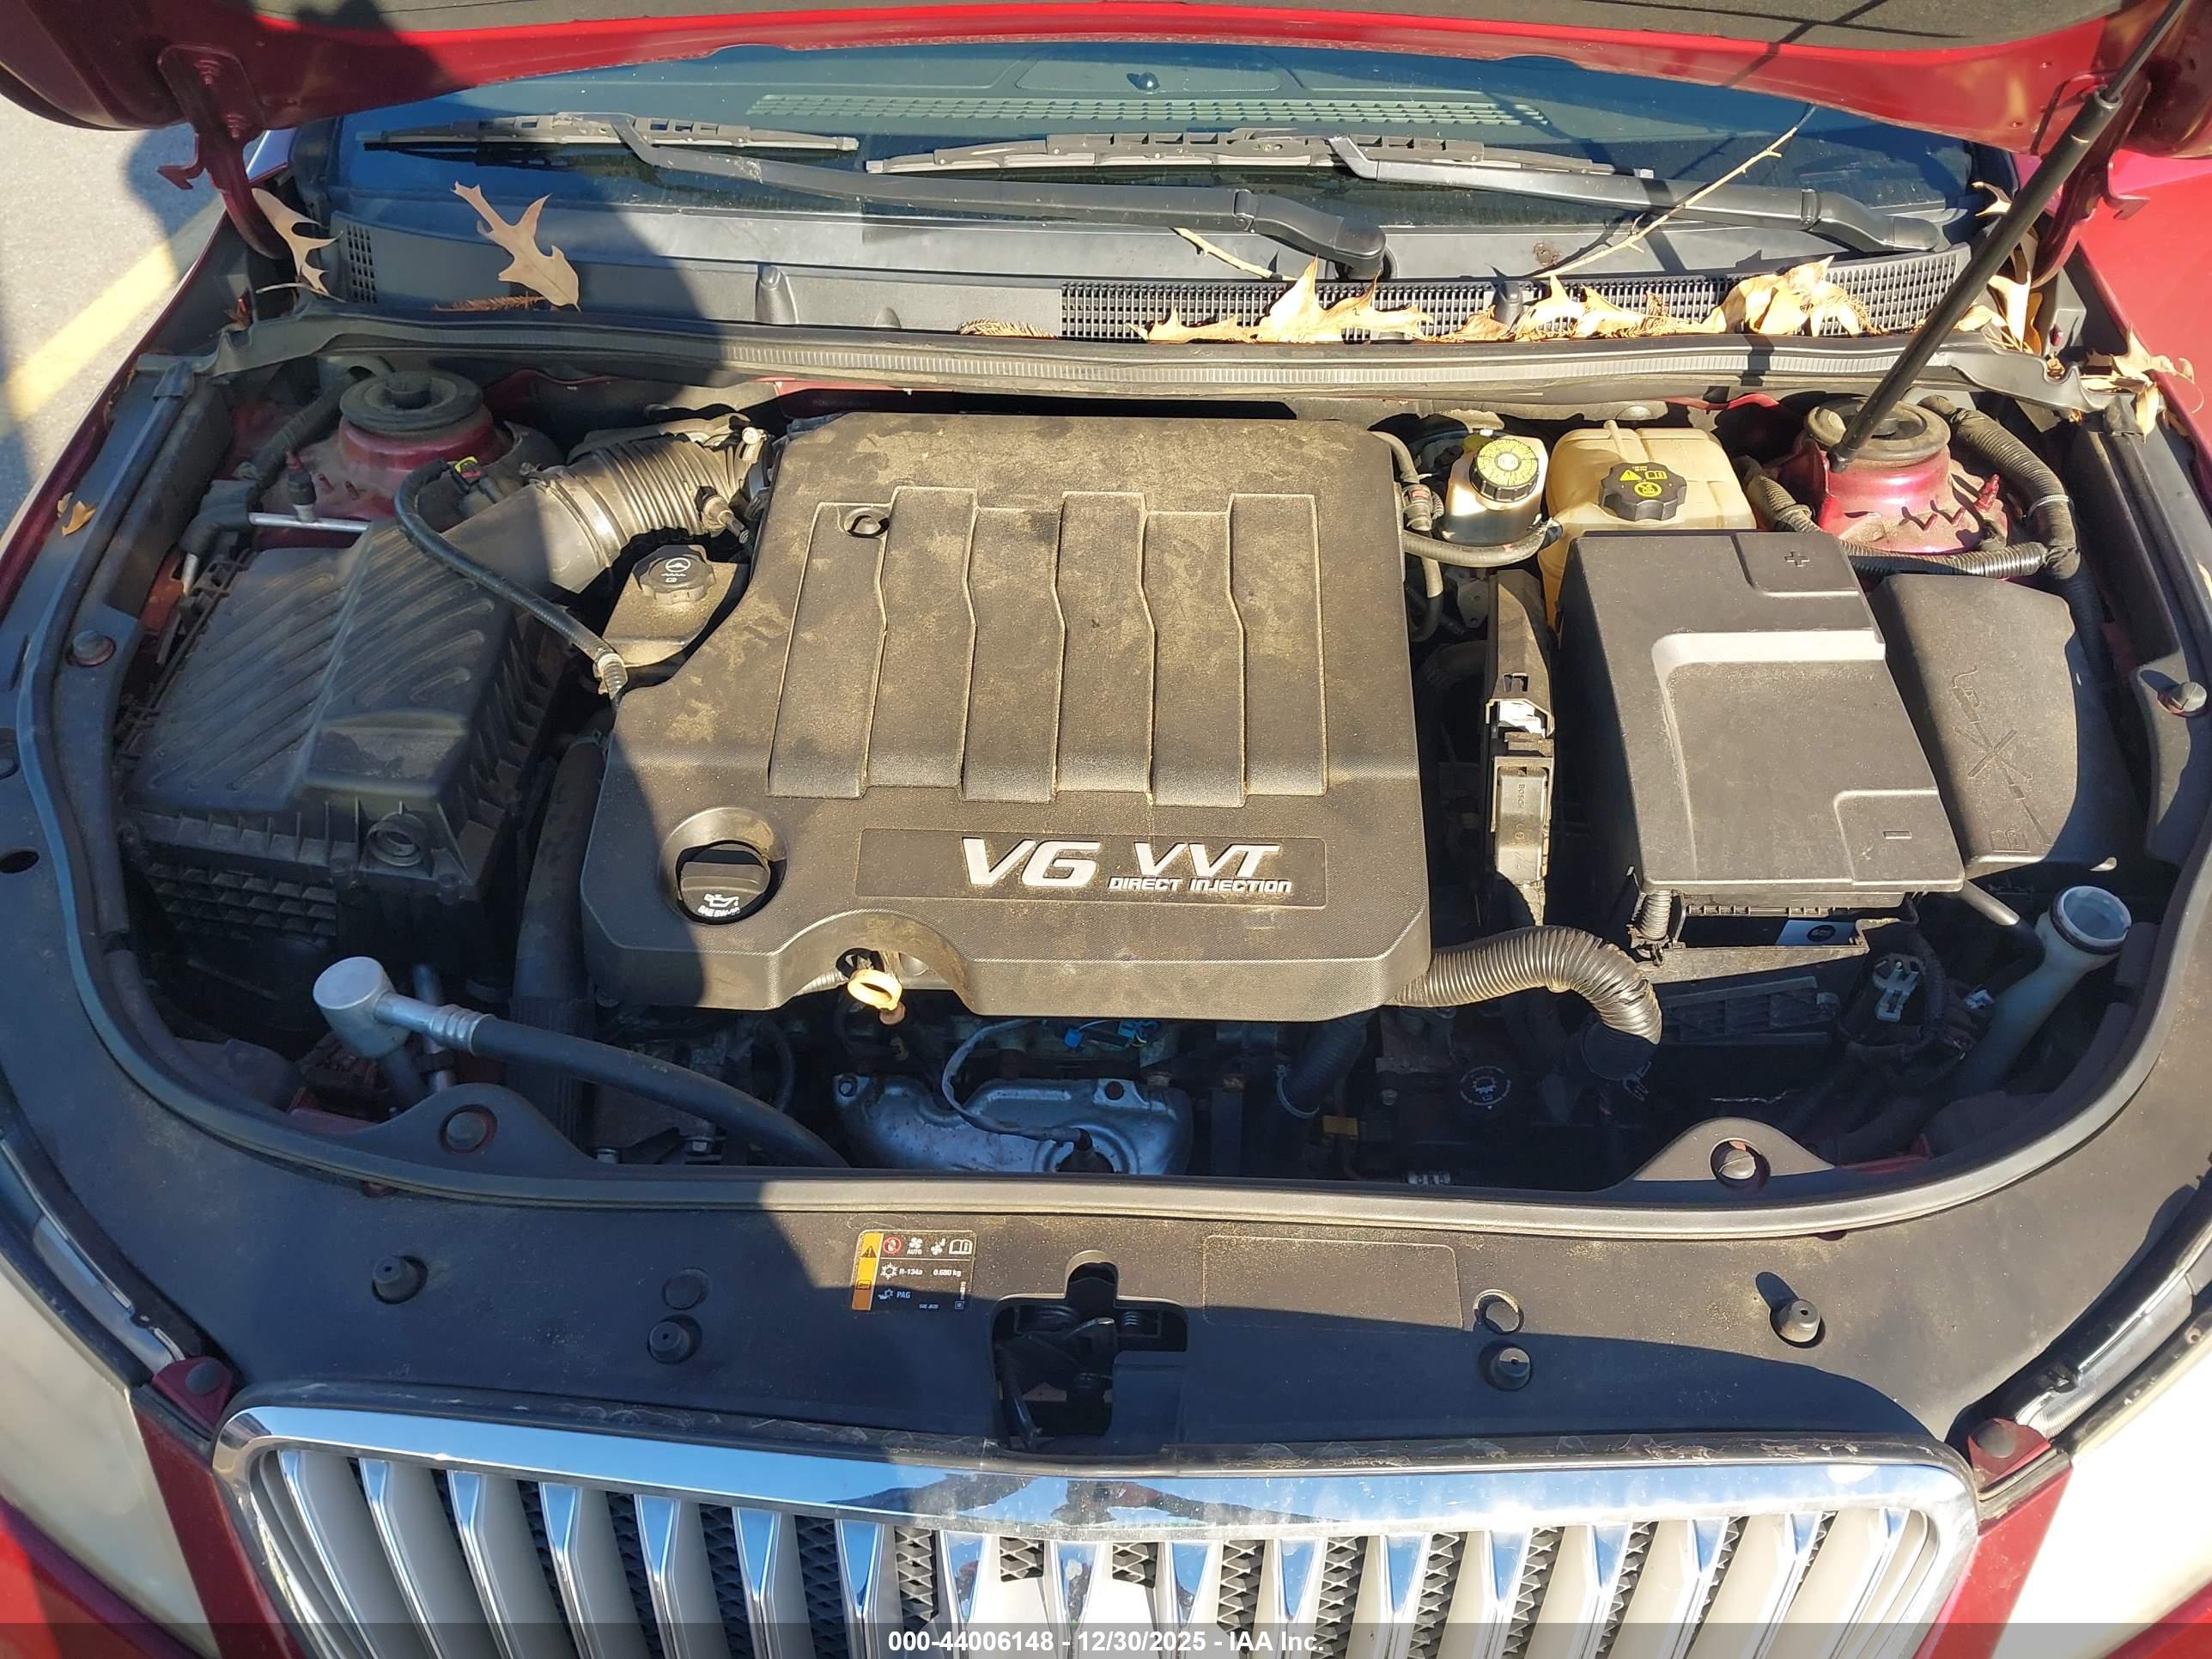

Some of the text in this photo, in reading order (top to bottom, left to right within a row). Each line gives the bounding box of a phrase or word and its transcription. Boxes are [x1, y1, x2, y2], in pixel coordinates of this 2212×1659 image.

[962, 836, 1280, 888] V6 VVT
[1108, 876, 1292, 893] DIRECT INJECTION
[899, 1267, 923, 1276] R-134a
[952, 1269, 962, 1278] kg
[896, 1291, 911, 1299] PAG
